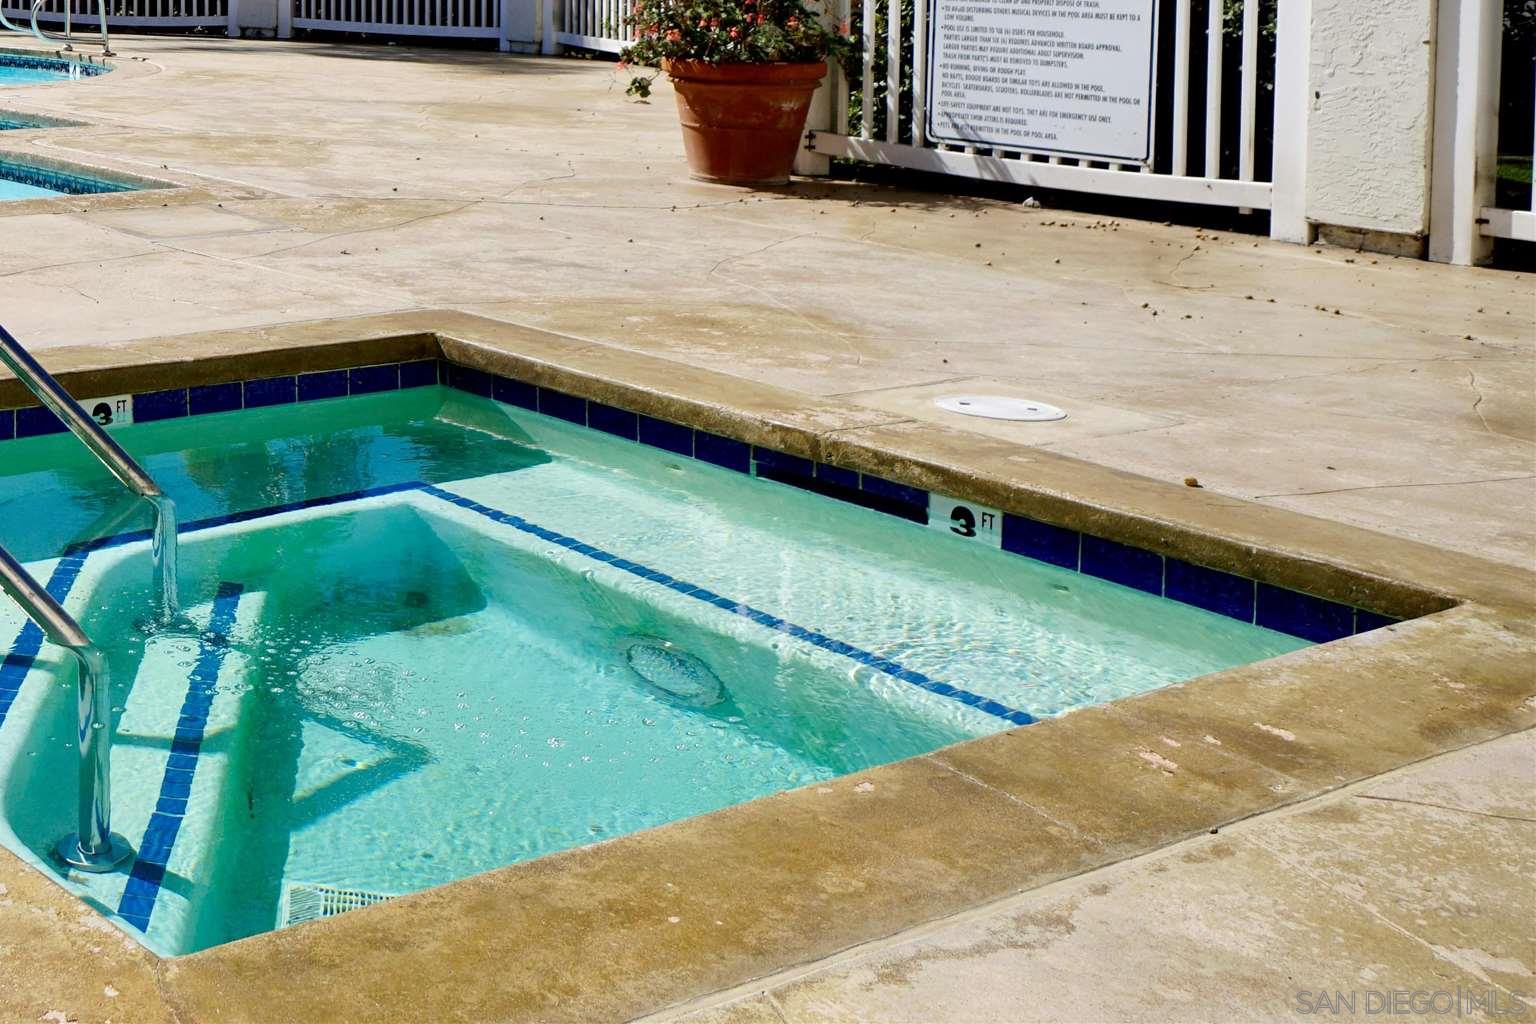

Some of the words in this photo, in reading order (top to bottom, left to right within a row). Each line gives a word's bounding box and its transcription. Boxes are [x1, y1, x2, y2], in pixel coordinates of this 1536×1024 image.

[92, 402, 114, 426] 3
[116, 400, 127, 413] FT
[950, 506, 976, 538] 3
[982, 512, 995, 530] FT
